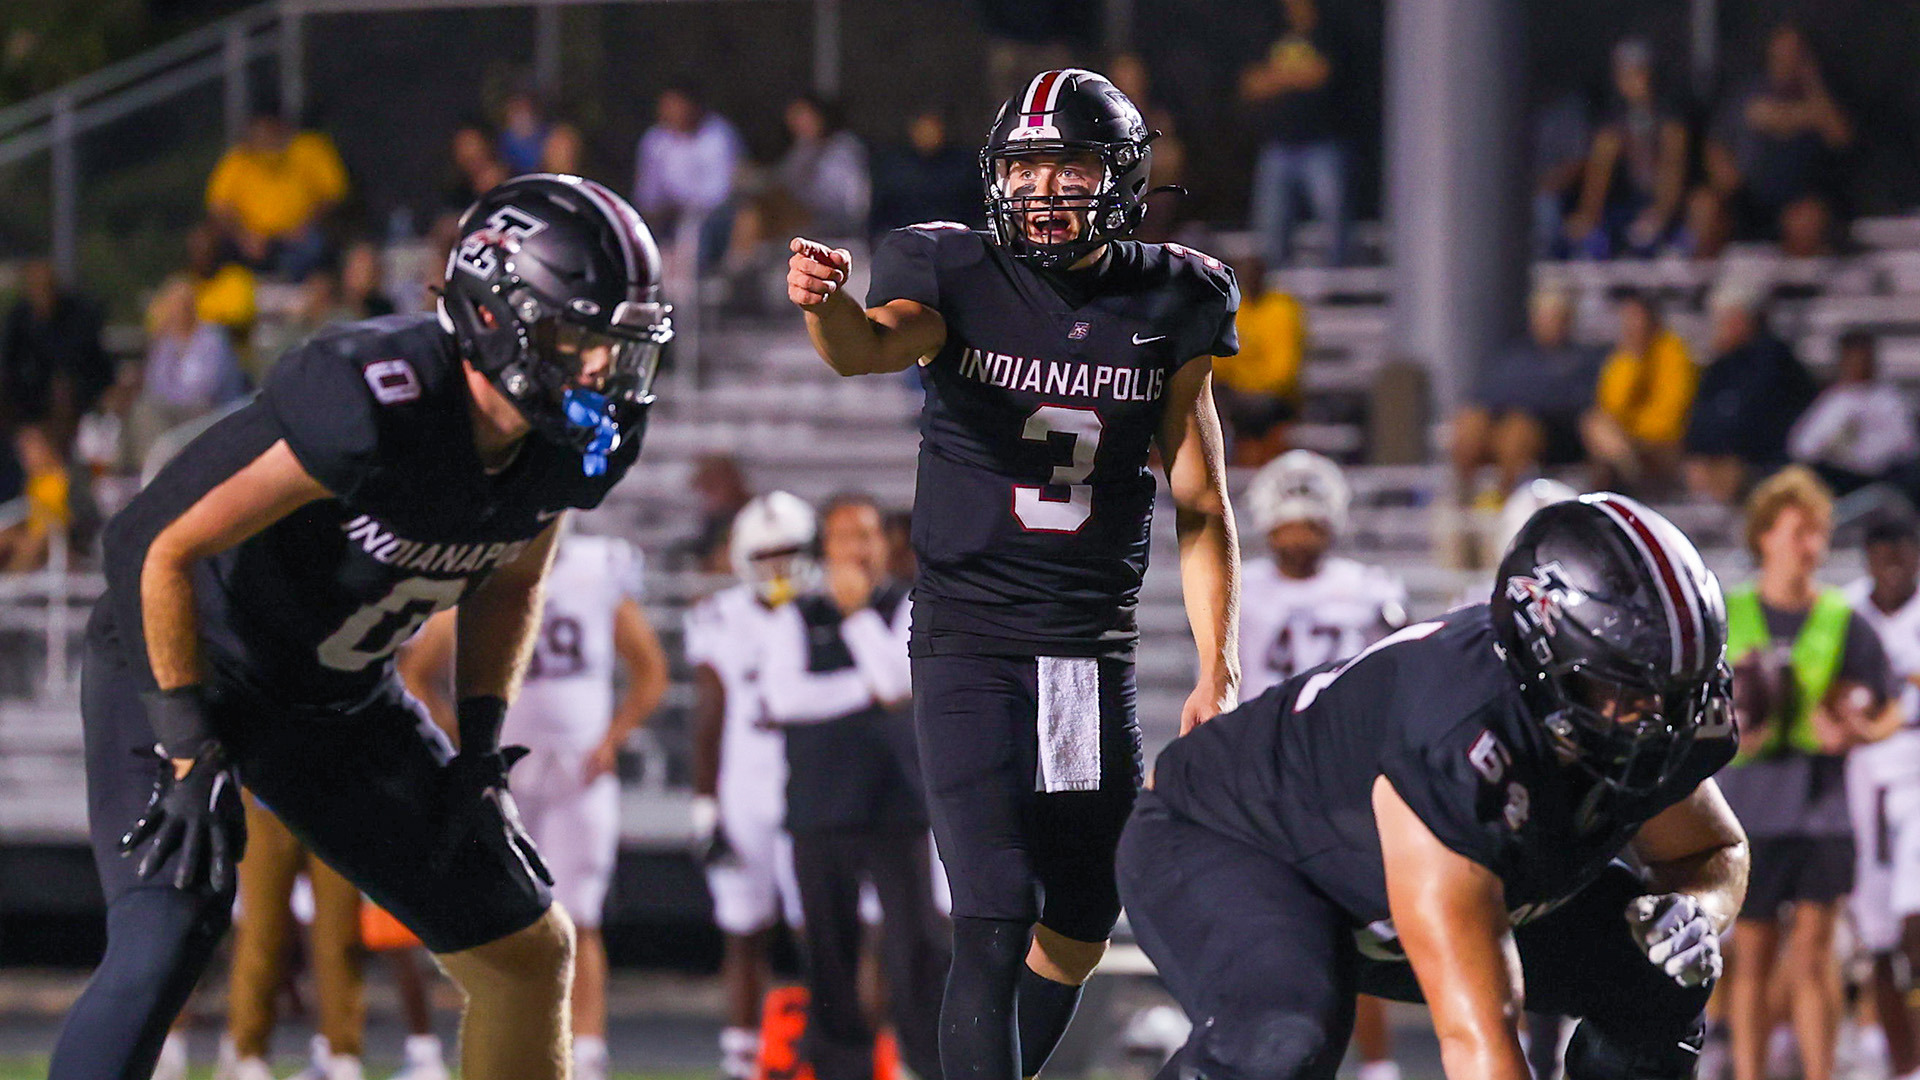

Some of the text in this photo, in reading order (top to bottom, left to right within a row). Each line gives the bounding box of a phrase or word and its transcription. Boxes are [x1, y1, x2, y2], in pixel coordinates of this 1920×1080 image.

[363, 357, 421, 404] 0
[958, 346, 1165, 402] INDIANAPOLIS
[1010, 402, 1106, 534] 3
